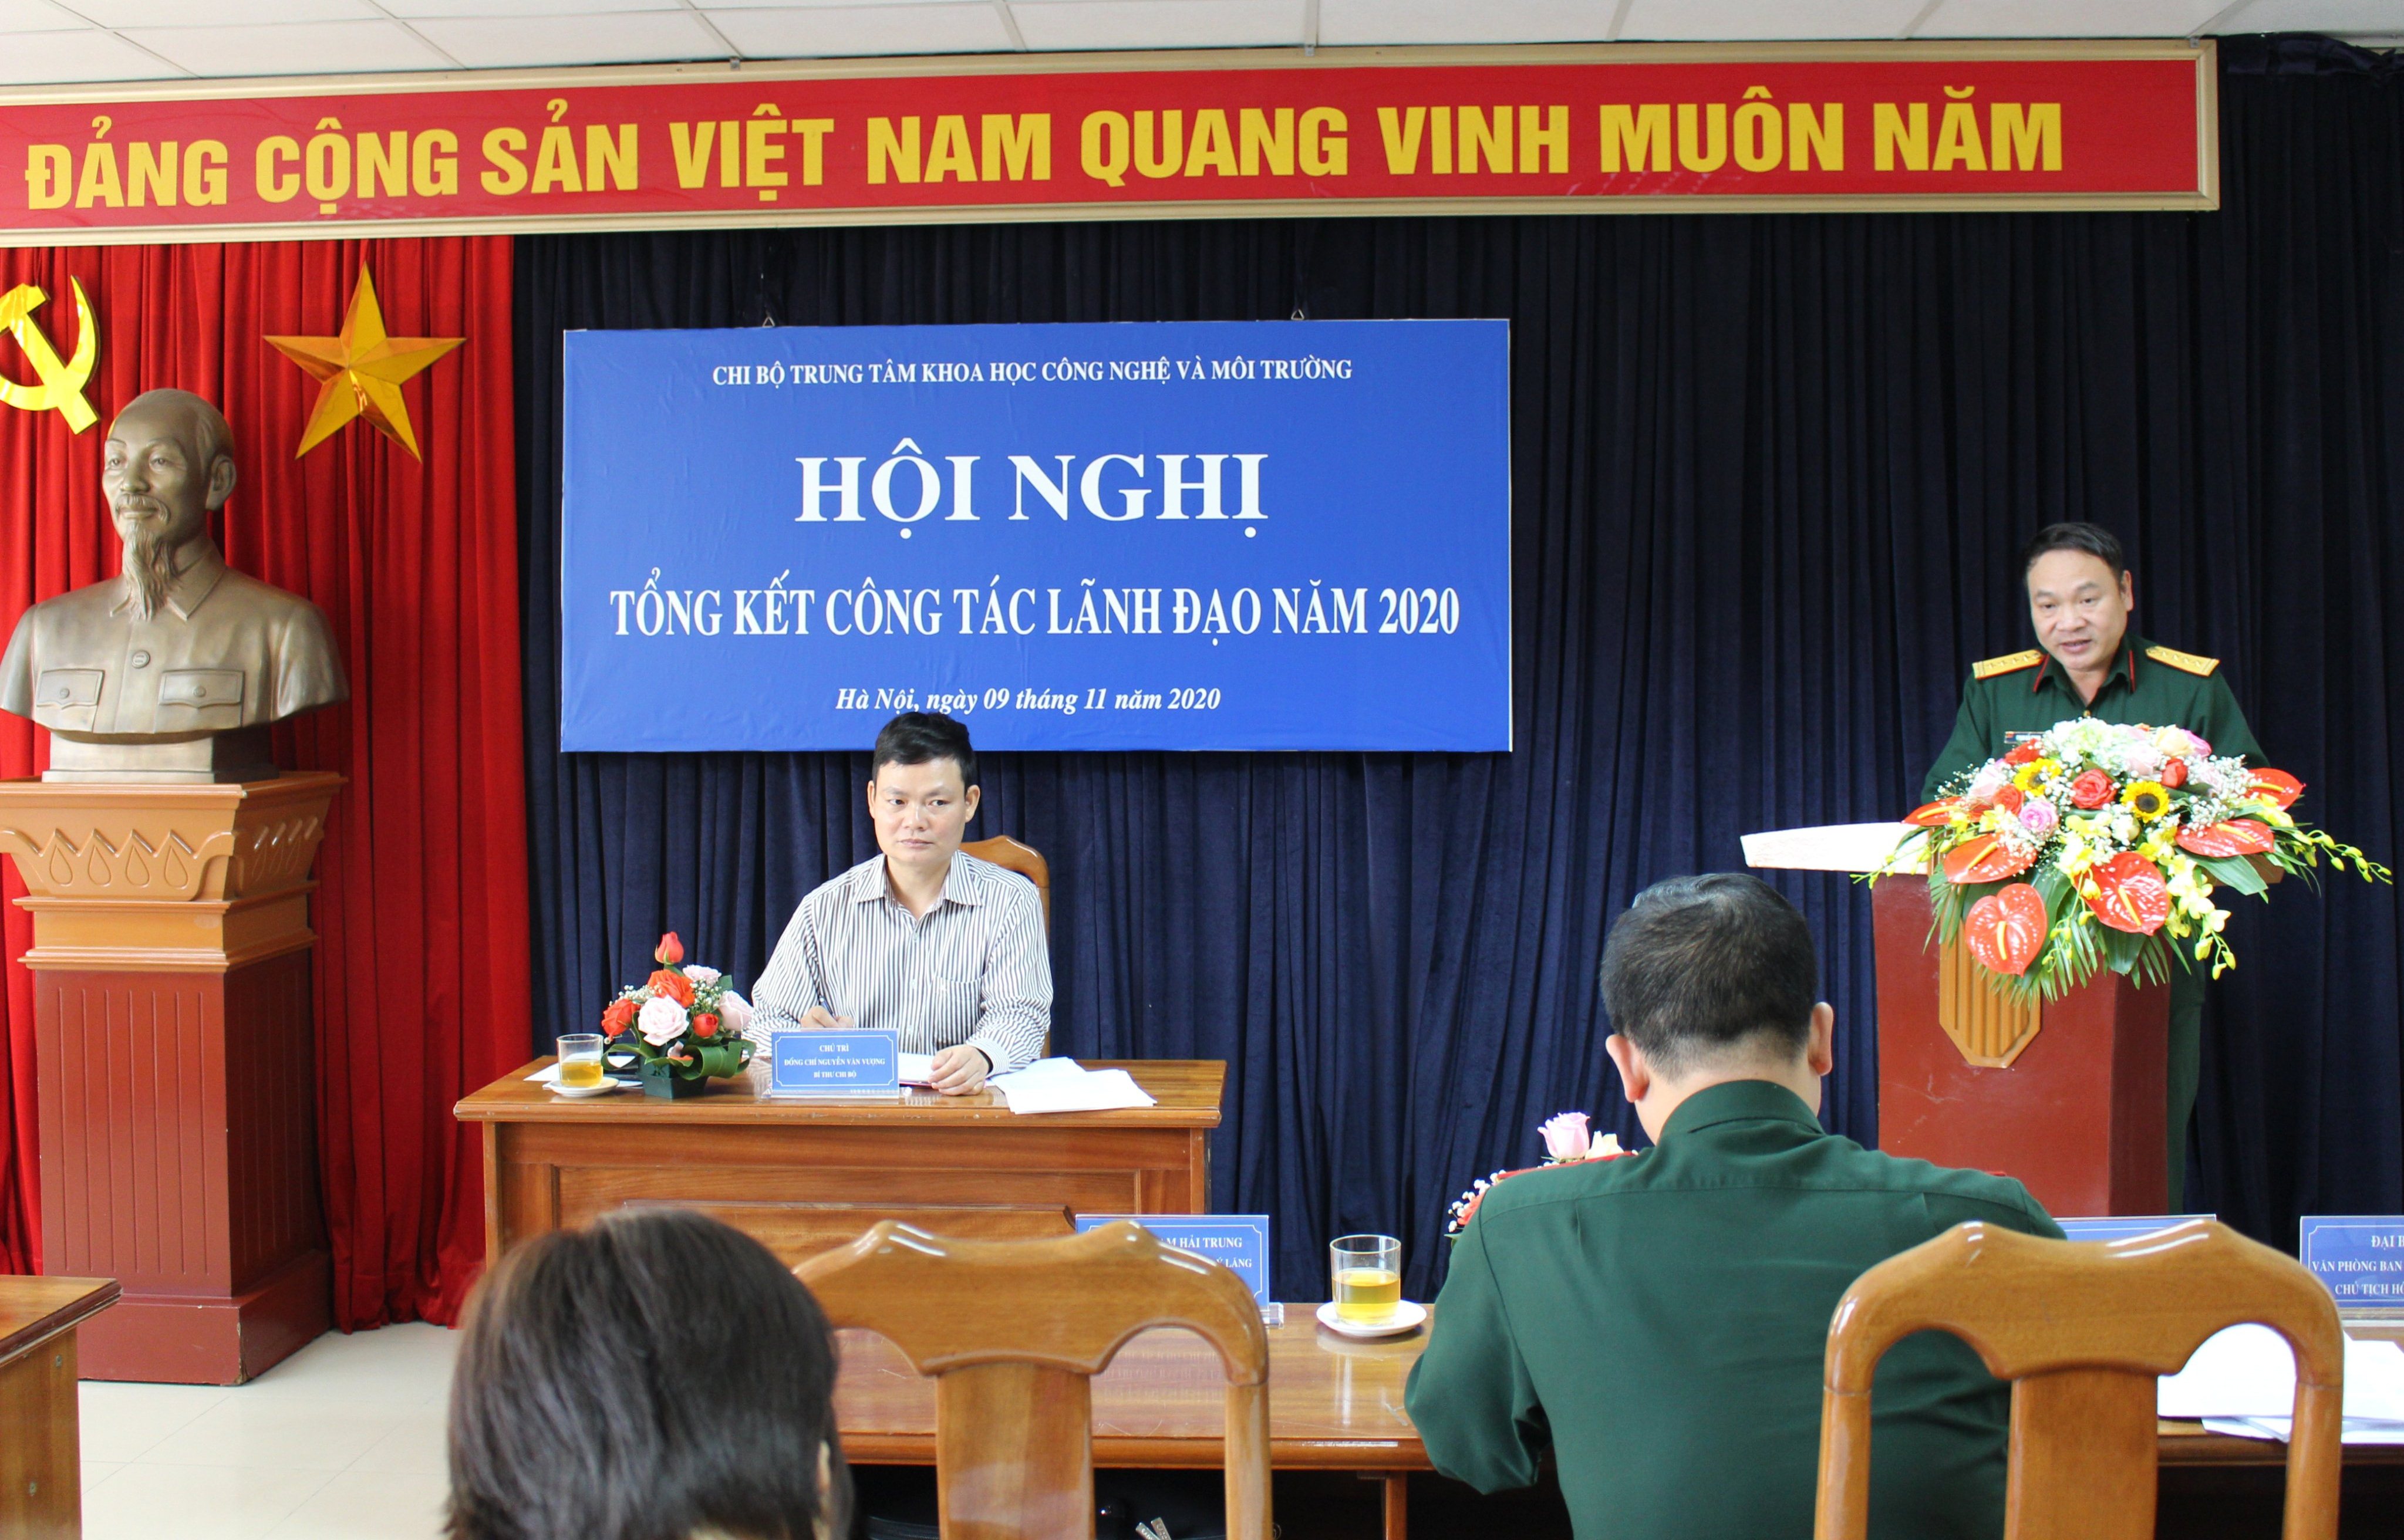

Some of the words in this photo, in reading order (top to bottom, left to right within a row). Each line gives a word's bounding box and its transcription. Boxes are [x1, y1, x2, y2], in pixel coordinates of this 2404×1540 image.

[25, 116, 228, 210] ĐẢNG
[256, 117, 457, 214] CỘNG
[481, 99, 638, 195] SẢN
[670, 104, 834, 201] VIỆT
[868, 114, 1050, 184] NAM
[1081, 107, 1347, 187] QUANG
[1378, 106, 1568, 174] VINH
[1601, 87, 1843, 172] MUÔN
[1874, 87, 2061, 170] NĂM
[713, 366, 751, 386] CHI
[756, 360, 785, 389] BỘ
[790, 364, 864, 384] TRUNG
[868, 359, 916, 383] TÂM
[922, 363, 984, 382] KHOA
[990, 362, 1036, 386] HỌC
[1041, 357, 1104, 381] CÔNG
[1109, 356, 1171, 384] NGHỆ
[1176, 356, 1205, 380] VÀ
[1211, 356, 1255, 380] MÔI
[1260, 354, 1352, 379] TRƯỜNG
[795, 438, 980, 539] HỘI
[1008, 454, 1268, 538] NGHỊ
[610, 567, 723, 636] TỔNG
[733, 569, 814, 634] KẾT
[826, 577, 942, 635] CÔNG
[953, 575, 1035, 634] TÁC
[1047, 579, 1162, 634] LÃNH
[1173, 588, 1261, 646] ĐẠO
[1273, 580, 1368, 633] NĂM
[1379, 588, 1459, 634] 2020
[835, 688, 869, 710] Hà
[874, 688, 919, 714] Nội,
[926, 689, 977, 714] ngày
[984, 688, 1009, 710] 09
[1016, 688, 1078, 714] tháng
[1084, 688, 1107, 710] 11
[1115, 689, 1162, 710] năm
[1168, 688, 1221, 710] 2020
[1202, 1237, 1242, 1248] TRUNG
[2371, 1235, 2396, 1251] ĐẠI
[2312, 1259, 2335, 1272] VĂN
[2338, 1258, 2377, 1272] PHÒNG
[2379, 1261, 2402, 1272] BAN
[2361, 1284, 2388, 1296] TỊCH
